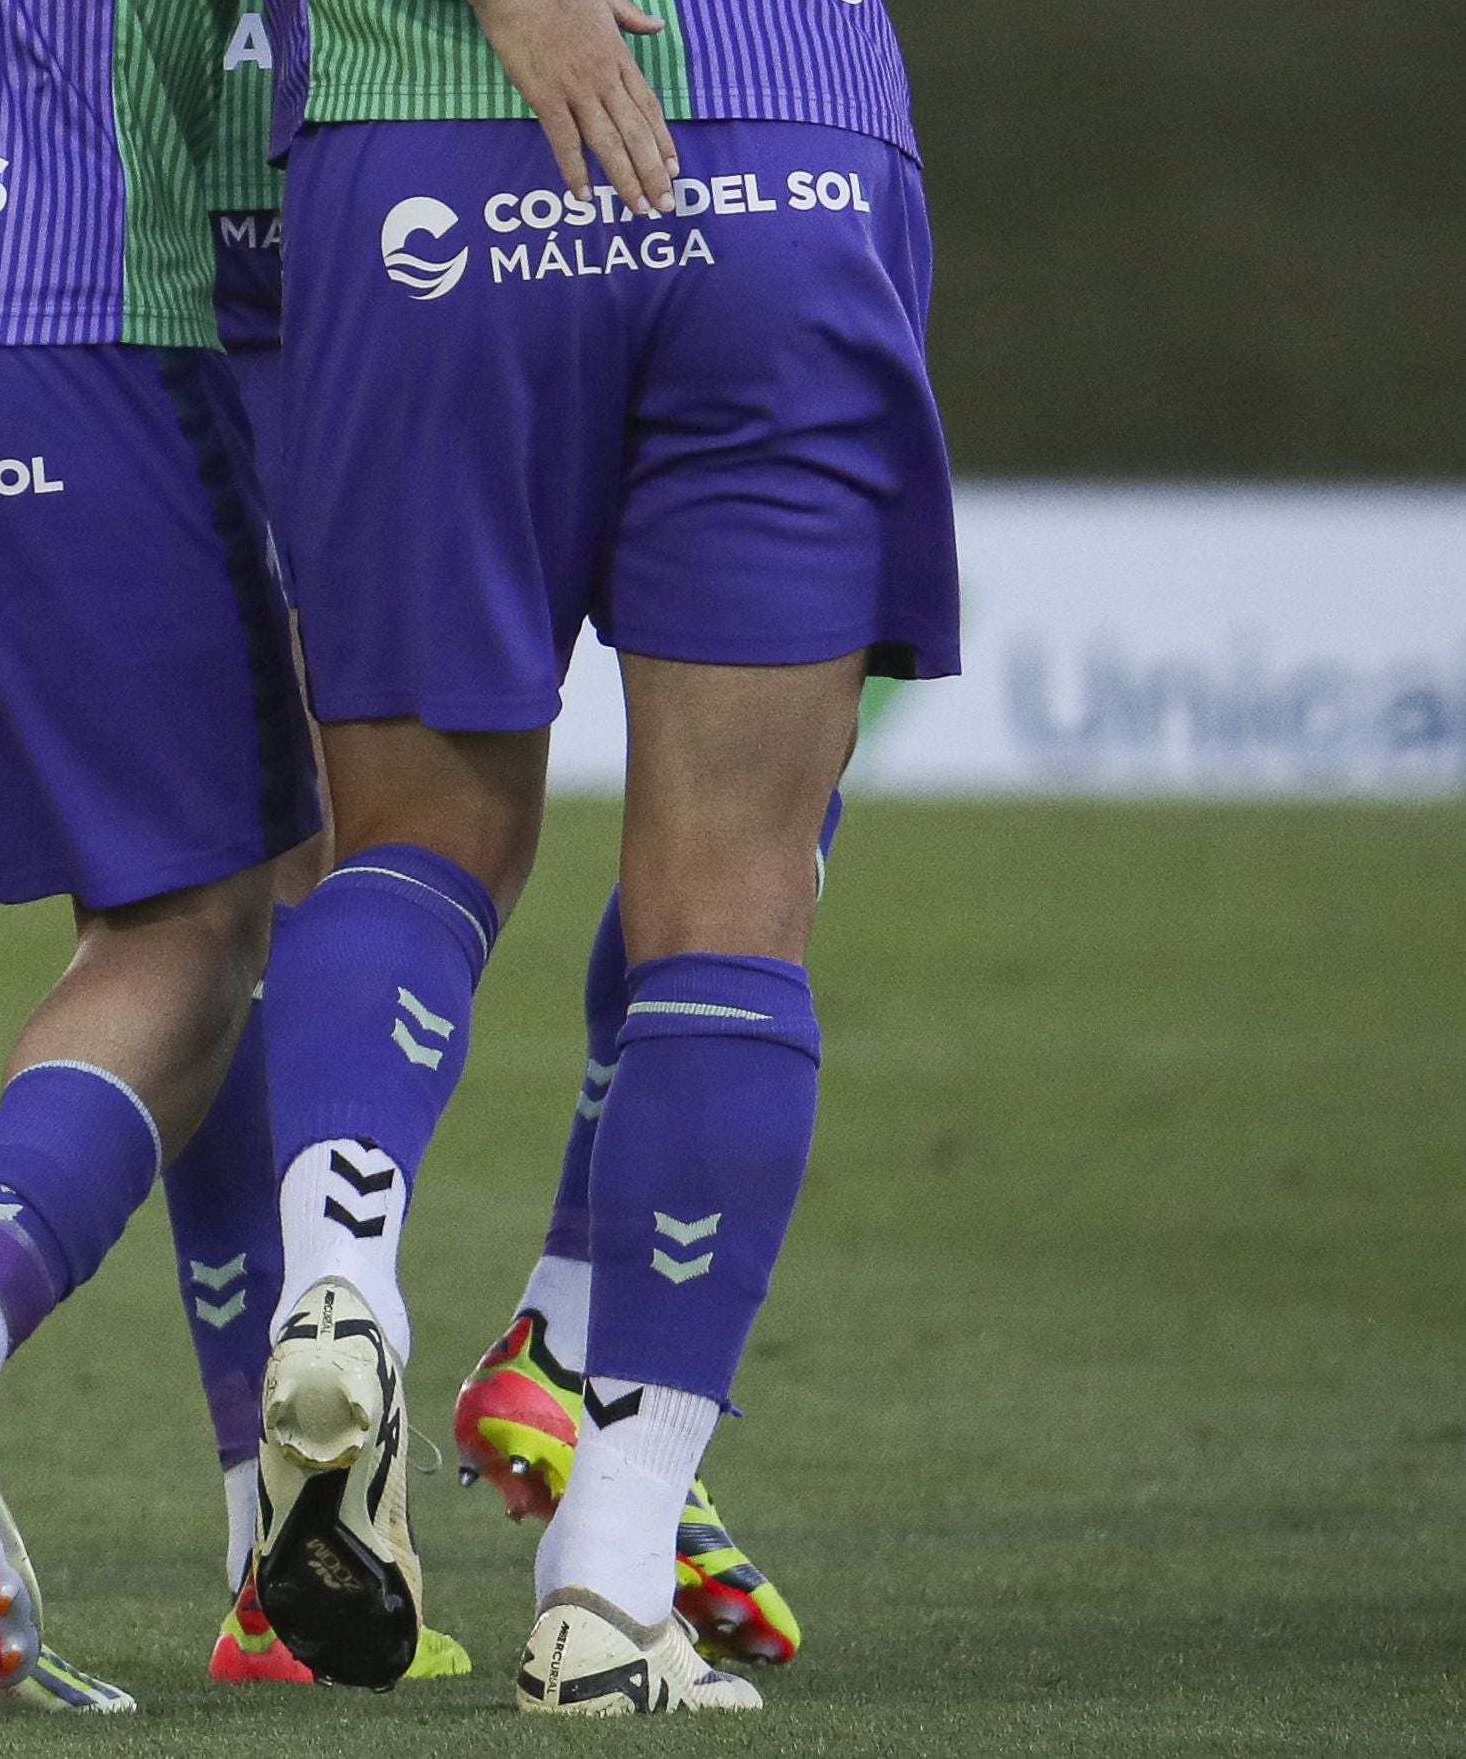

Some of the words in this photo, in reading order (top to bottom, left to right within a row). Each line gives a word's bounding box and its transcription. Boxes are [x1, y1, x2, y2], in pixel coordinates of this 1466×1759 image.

[675, 172, 777, 219] DEL
[786, 169, 870, 214] SOL
[488, 228, 715, 283] MÁLAGA
[1005, 620, 1466, 770] Unica
[546, 1620, 571, 1695] MERCURIAL
